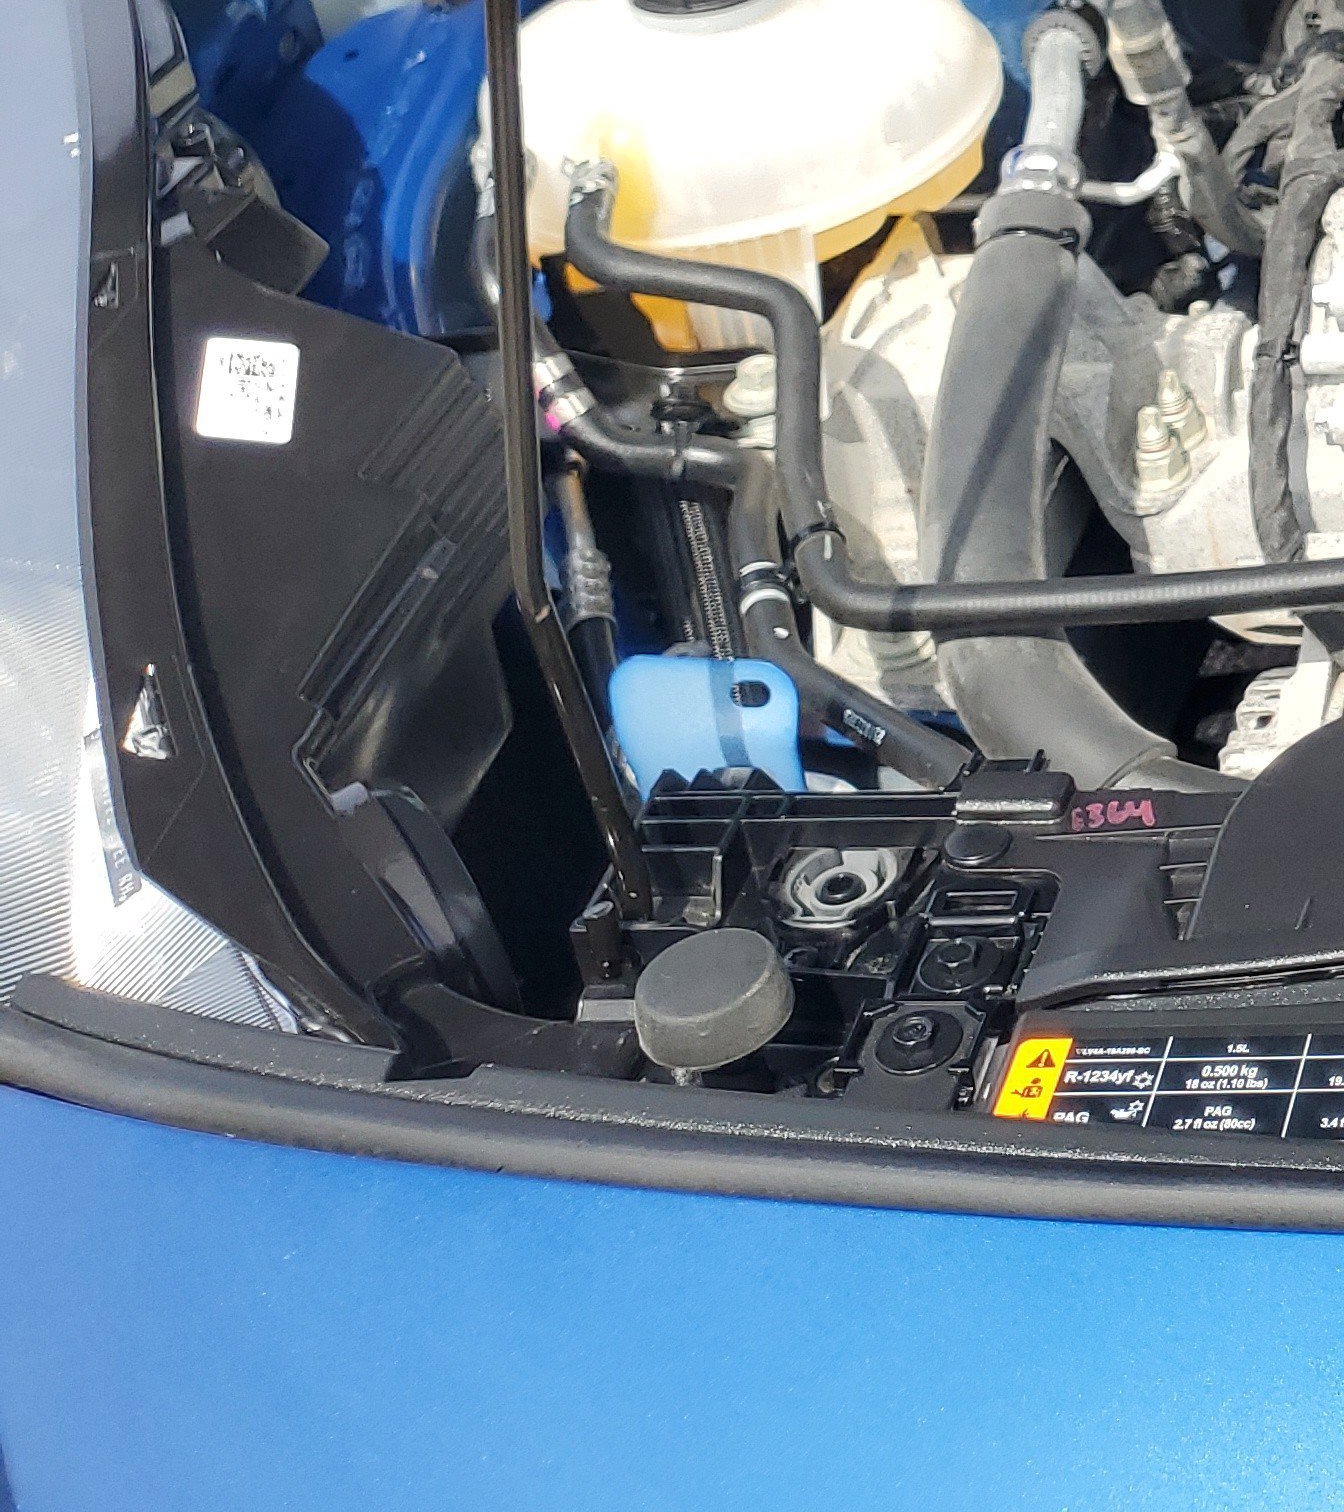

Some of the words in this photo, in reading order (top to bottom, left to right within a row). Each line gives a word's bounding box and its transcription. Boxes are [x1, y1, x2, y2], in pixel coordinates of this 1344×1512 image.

[1227, 1044, 1250, 1054] 1.5L
[1064, 1070, 1136, 1085] R-1234yf
[1202, 1065, 1239, 1078] 0.500
[1240, 1064, 1259, 1079] kg
[1186, 1079, 1200, 1090] 18
[1201, 1081, 1216, 1089] oz
[1217, 1079, 1245, 1090] (1.10
[1246, 1078, 1269, 1090] lbs)
[1204, 1106, 1233, 1117] PAG
[1053, 1111, 1090, 1125] PAG
[1173, 1119, 1193, 1130] 2.7
[1193, 1118, 1203, 1130] fl
[1204, 1121, 1219, 1129] oz
[1320, 1118, 1339, 1129] 3.4
